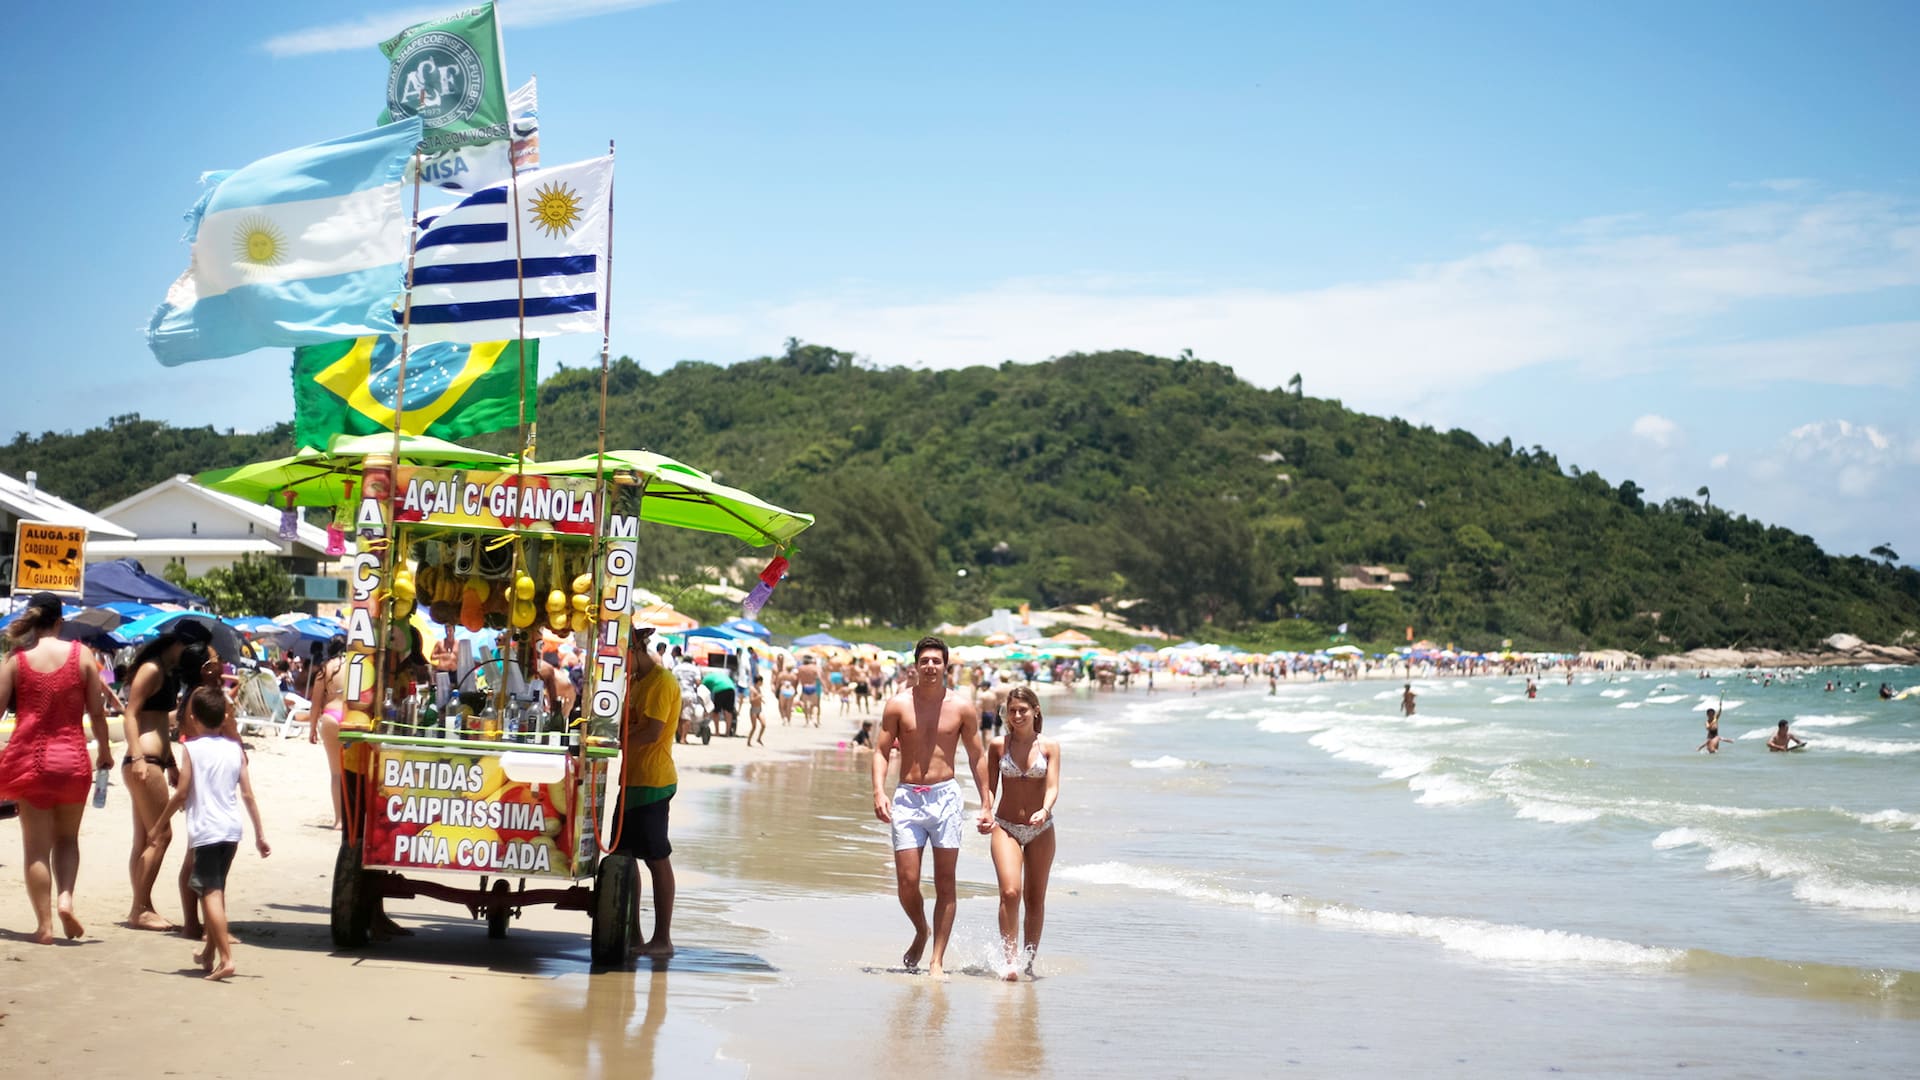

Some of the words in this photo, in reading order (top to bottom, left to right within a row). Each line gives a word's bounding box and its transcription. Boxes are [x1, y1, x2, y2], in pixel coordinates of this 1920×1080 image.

[461, 49, 474, 66] DE
[420, 156, 469, 182] VISA
[403, 475, 457, 520] AÇAÍ
[463, 484, 484, 516] C/
[490, 485, 594, 523] GRANOLA
[24, 543, 58, 556] CADEIRAS
[26, 528, 80, 542] ALUGA-SE
[34, 574, 62, 585] GUARDA
[348, 497, 382, 702] AÇAÍ
[592, 514, 640, 717] MOJITO
[384, 758, 483, 793] BATIDAS
[386, 794, 547, 832] CAIPIRISSIMA
[394, 831, 450, 866] PIÑA
[457, 838, 551, 872] COLADA
